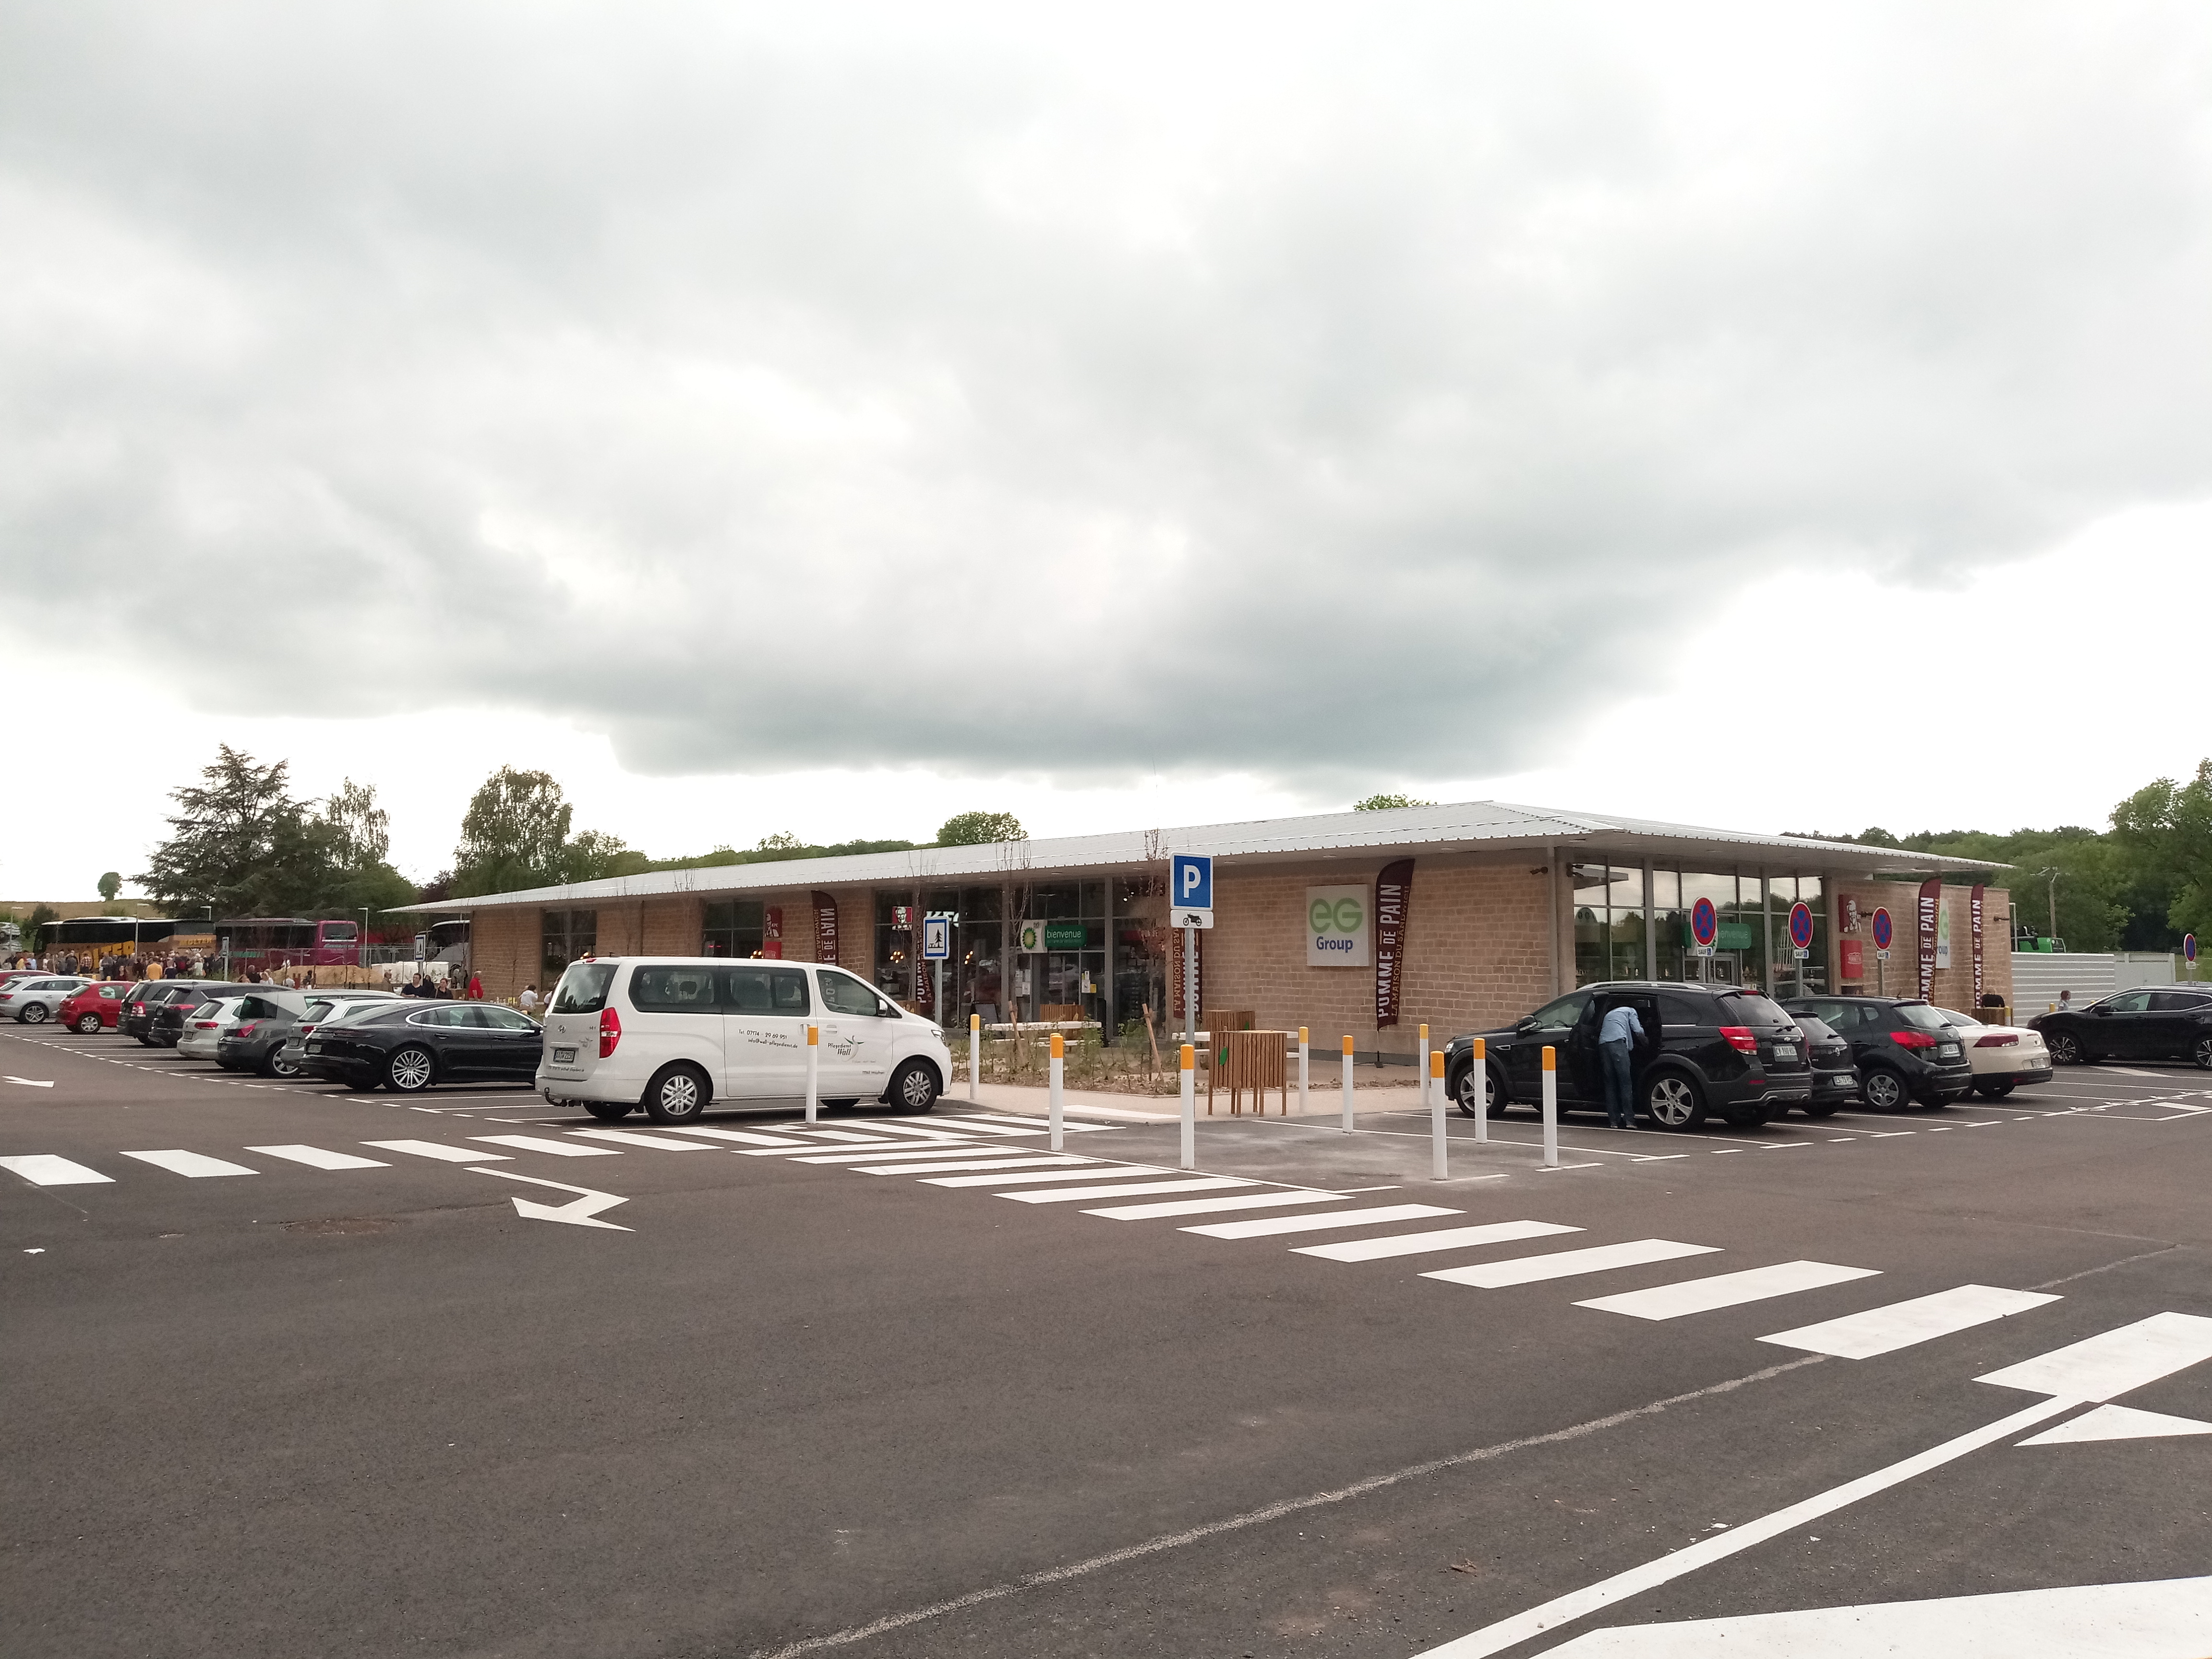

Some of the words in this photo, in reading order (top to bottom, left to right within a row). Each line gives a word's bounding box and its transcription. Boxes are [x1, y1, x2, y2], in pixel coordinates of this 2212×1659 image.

[1184, 865, 1201, 898] P
[1380, 884, 1401, 924] PAIN
[1397, 886, 1411, 942] SANDWICH
[1921, 897, 1934, 931] PAIN
[1972, 900, 1982, 932] PAIN
[1047, 930, 1081, 938] bienvenue
[1316, 936, 1353, 953] Group
[1383, 930, 1396, 944] DE
[1923, 937, 1931, 948] DE
[1395, 944, 1402, 958] DU
[1378, 951, 1395, 1018] POMME
[1392, 961, 1401, 1001] MAISON
[1921, 954, 1934, 1000] OMME
[1392, 1004, 1398, 1017] LA
